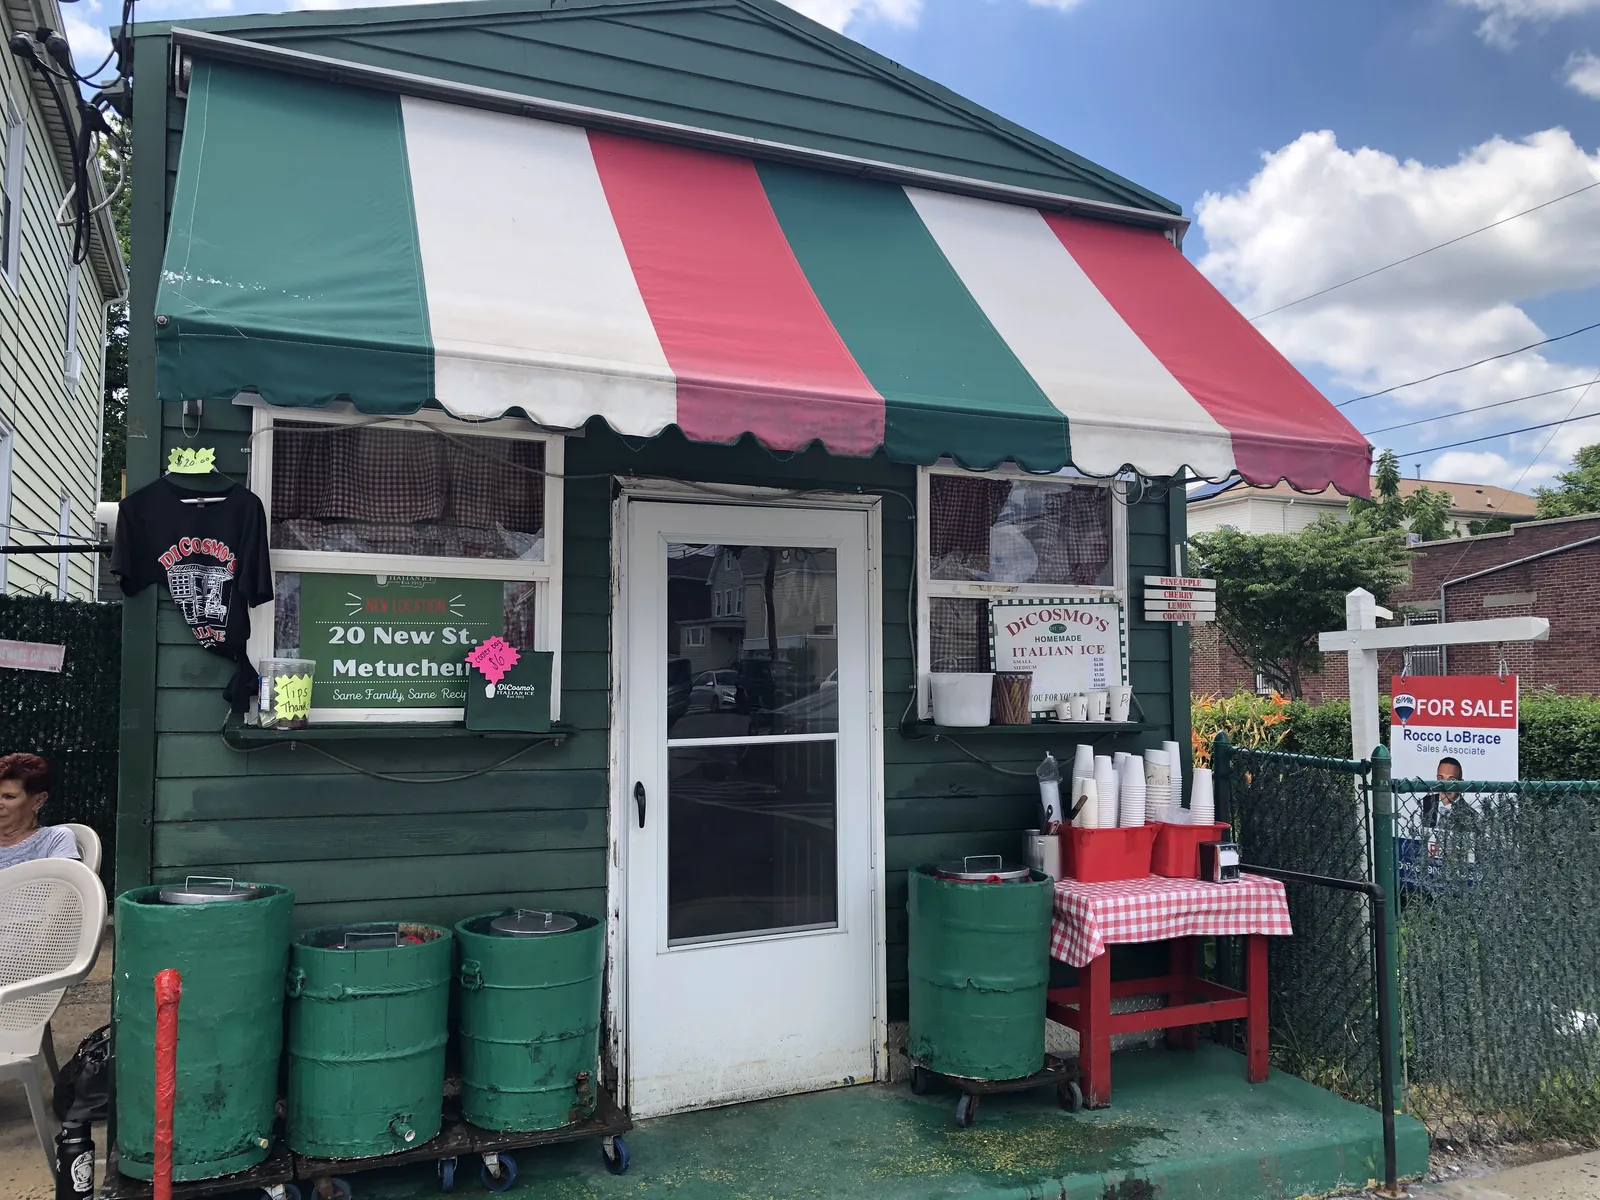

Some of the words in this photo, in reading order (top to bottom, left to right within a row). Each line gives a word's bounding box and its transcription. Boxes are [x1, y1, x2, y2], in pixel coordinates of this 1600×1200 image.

[158, 536, 238, 573] DICOSMO'S
[1160, 578, 1201, 586] PINEAPPLE
[1164, 591, 1194, 599] CHERRY
[365, 598, 389, 612] NEW
[392, 598, 446, 613] LOCATION
[1004, 608, 1109, 637] DiCOSMO'S
[328, 626, 366, 644] 20
[373, 626, 435, 644] New
[442, 627, 478, 645] St.
[0, 646, 27, 662] EWARE
[1012, 646, 1074, 657] ITALIAN
[1081, 645, 1105, 655] ICE
[333, 659, 471, 677] Metuchen
[281, 680, 308, 704] Tips
[333, 688, 363, 700] Same
[365, 688, 405, 702] Family,
[408, 688, 437, 700] Same
[1099, 701, 1104, 715] L
[1416, 699, 1455, 716] FOR
[1461, 700, 1513, 717] SALE
[1403, 729, 1442, 742] Rocco
[1446, 730, 1501, 744] LoBrace
[1417, 744, 1440, 753] Sales
[1442, 745, 1486, 755] Associate
